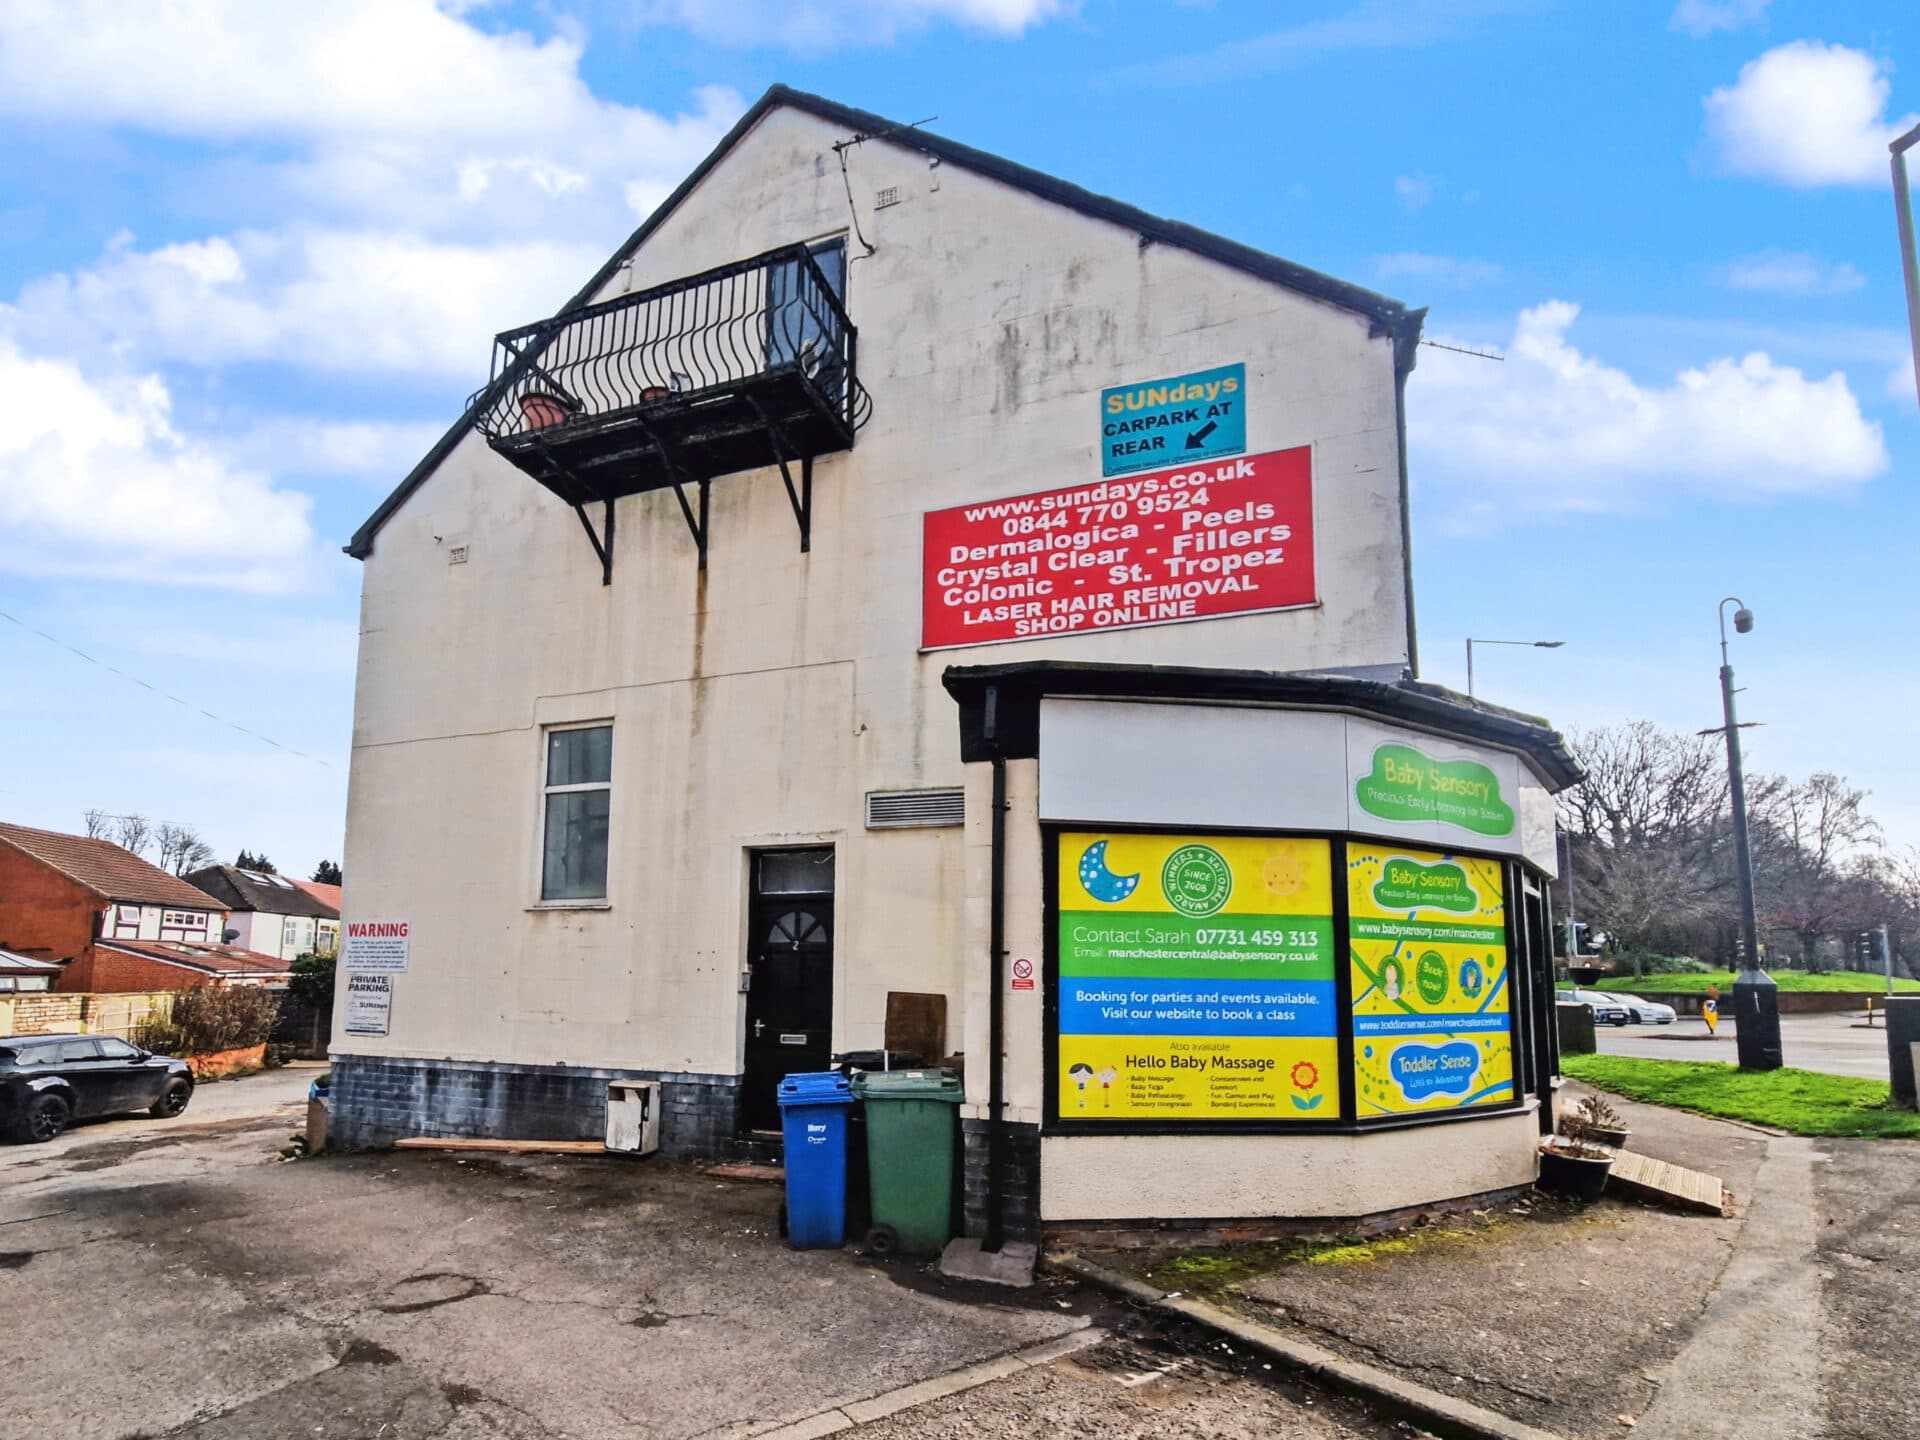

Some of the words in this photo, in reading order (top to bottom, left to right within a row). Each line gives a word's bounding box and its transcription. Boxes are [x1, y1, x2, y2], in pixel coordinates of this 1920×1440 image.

[1107, 378, 1238, 413] SUNdays
[1104, 408, 1199, 436] CARPARK
[1206, 402, 1232, 418] AT
[1112, 436, 1165, 457] REAR
[965, 460, 1255, 522] www.sundays.co.uk
[1003, 511, 1068, 536] 0844
[1077, 502, 1127, 524] 770
[1137, 488, 1209, 515] 9524
[951, 524, 1138, 563] Dermalogica
[1182, 502, 1274, 530] Peels
[937, 557, 1037, 587] Crystal
[1048, 547, 1129, 571] Clear
[1173, 525, 1291, 555] Fillers
[944, 578, 1053, 606] Colonic
[1108, 563, 1152, 584] St.
[1163, 548, 1284, 577] Tropez
[964, 602, 1042, 625] LASER
[1051, 593, 1114, 614] HAIR
[1124, 575, 1259, 605] REMOVAL
[1015, 614, 1084, 635] SHOP
[1093, 600, 1196, 624] ONLINE
[1384, 757, 1424, 792] Baby
[1430, 768, 1490, 804] Sensory
[1184, 869, 1211, 881] SINCE
[1391, 867, 1418, 888] Baby
[1420, 871, 1461, 891] Sensory
[348, 923, 408, 937] WARNING
[1073, 926, 1141, 943] Contact
[1145, 927, 1191, 944] Sarah
[1196, 929, 1247, 945] 07731
[1251, 929, 1283, 946] 459
[1288, 931, 1318, 946] 313
[348, 984, 389, 992] PARKING
[351, 976, 388, 984] PRIVATE
[1076, 990, 1127, 1004] Booking
[1131, 991, 1148, 1001] for
[1152, 991, 1193, 1004] parties
[1196, 992, 1218, 1003] and
[1222, 993, 1261, 1003] events
[1264, 993, 1319, 1004] available.
[1102, 1007, 1128, 1018] Visit
[1131, 1010, 1152, 1019] our
[1155, 1008, 1202, 1019] website
[1206, 1009, 1219, 1019] to
[1222, 1009, 1253, 1020] book
[1256, 1011, 1263, 1020] a
[1266, 1010, 1295, 1020] class
[1170, 1042, 1189, 1051] Also
[1192, 1042, 1231, 1051] available
[1126, 1055, 1166, 1068] Hello
[1170, 1055, 1207, 1072] Baby
[1212, 1056, 1275, 1072] Massage
[1399, 1056, 1437, 1074] Toddler
[1440, 1055, 1471, 1070] Sense
